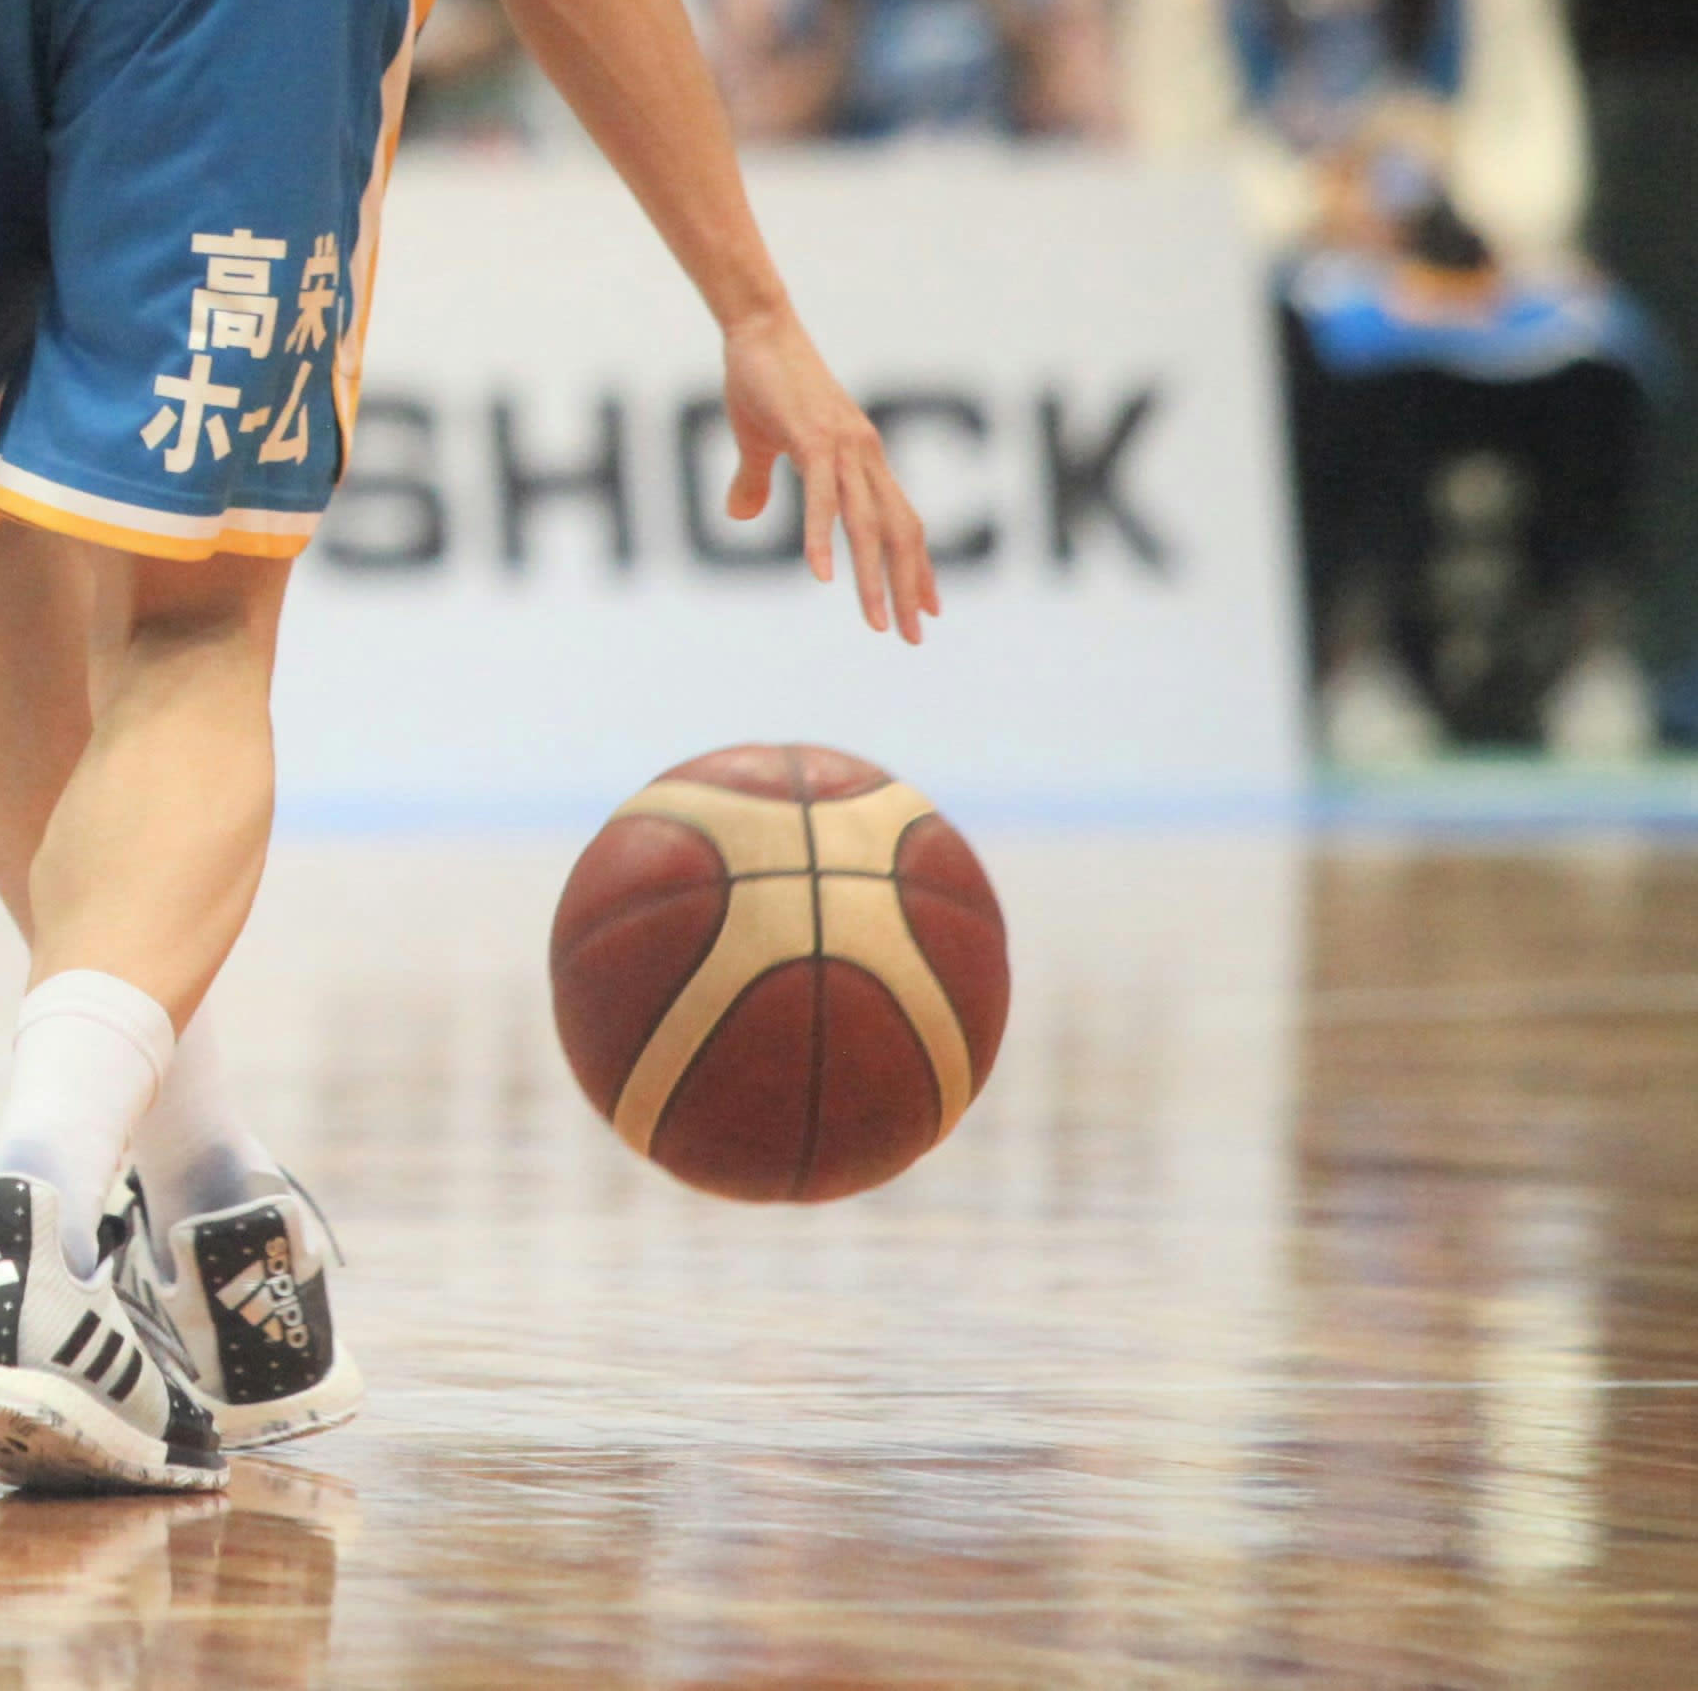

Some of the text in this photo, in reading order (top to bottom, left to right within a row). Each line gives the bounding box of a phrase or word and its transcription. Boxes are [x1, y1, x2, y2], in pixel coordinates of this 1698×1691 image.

[187, 228, 340, 360] 高栄
[140, 355, 310, 473] ホーム
[265, 1235, 309, 1349] adidas
